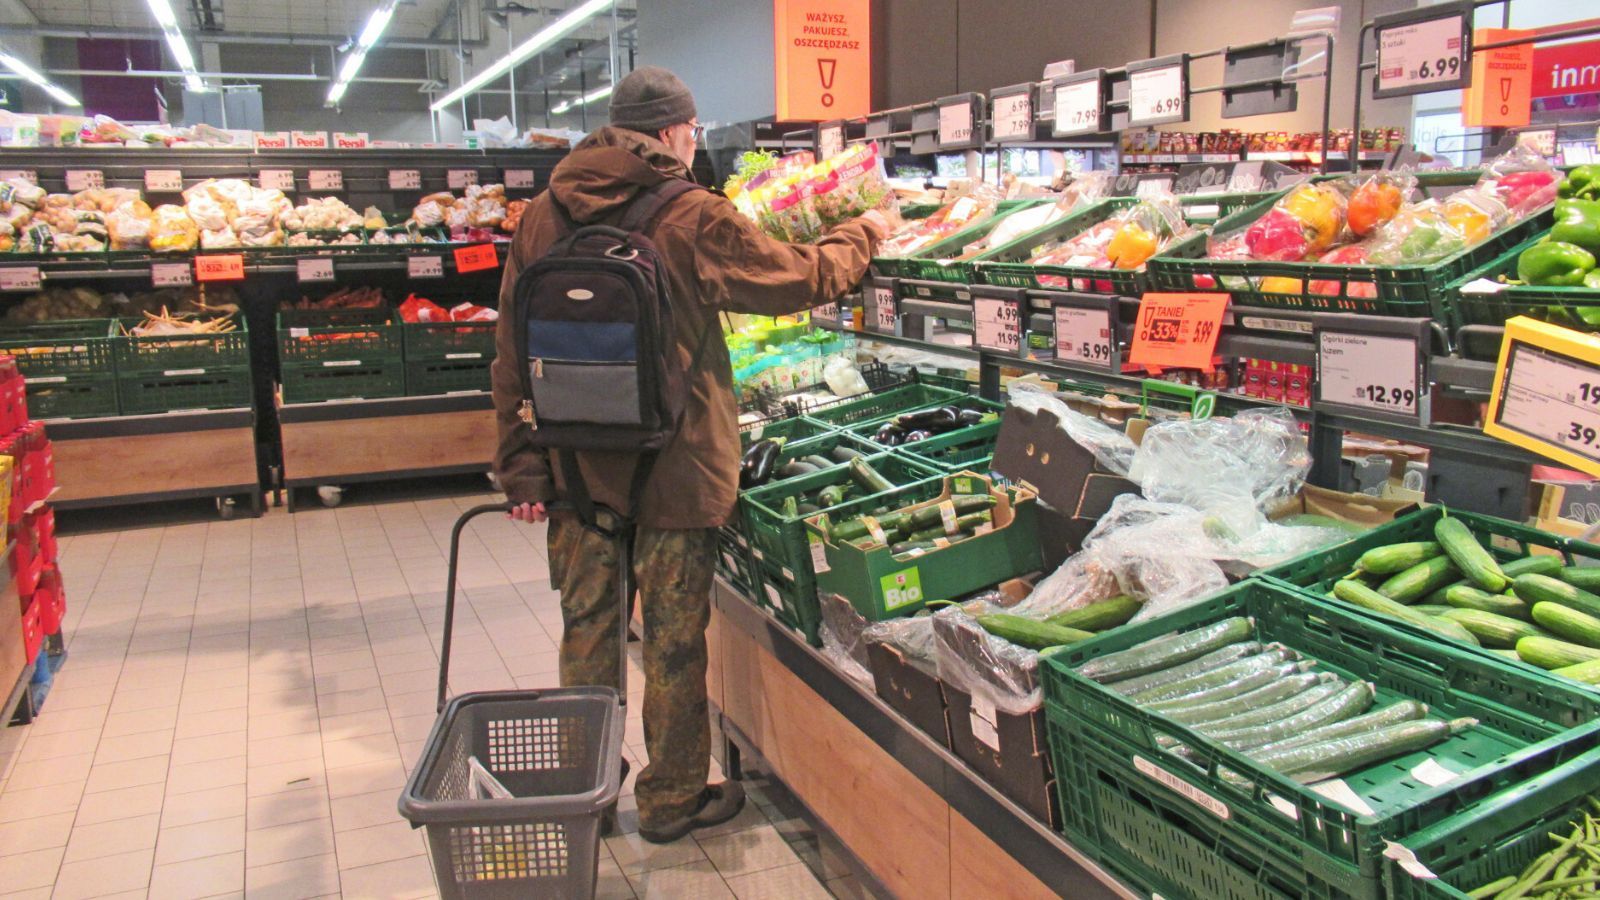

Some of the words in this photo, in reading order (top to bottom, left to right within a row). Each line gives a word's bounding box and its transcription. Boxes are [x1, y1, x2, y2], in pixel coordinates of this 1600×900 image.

[806, 12, 847, 24] WAŻYSZ,
[803, 25, 849, 37] PAKUJESZ,
[794, 38, 860, 50] OSZCZĘDZASZ
[1419, 56, 1459, 79] 6.99
[1012, 99, 1030, 113] 6.99
[1156, 98, 1180, 114] 6.99
[1076, 109, 1097, 124] 7.99
[1012, 119, 1030, 133] 7.99
[258, 138, 286, 148] Persil
[297, 137, 325, 147] Persil
[338, 139, 365, 148] Persil
[878, 294, 893, 306] 9.99
[880, 314, 894, 326] 7.99
[997, 306, 1018, 322] 4.99
[1151, 321, 1179, 340] -33%
[997, 331, 1018, 345] 11.99
[1082, 342, 1109, 361] 5.99
[1322, 345, 1344, 356] luzem
[1366, 384, 1414, 407] 12.99
[886, 586, 920, 608] Bio
